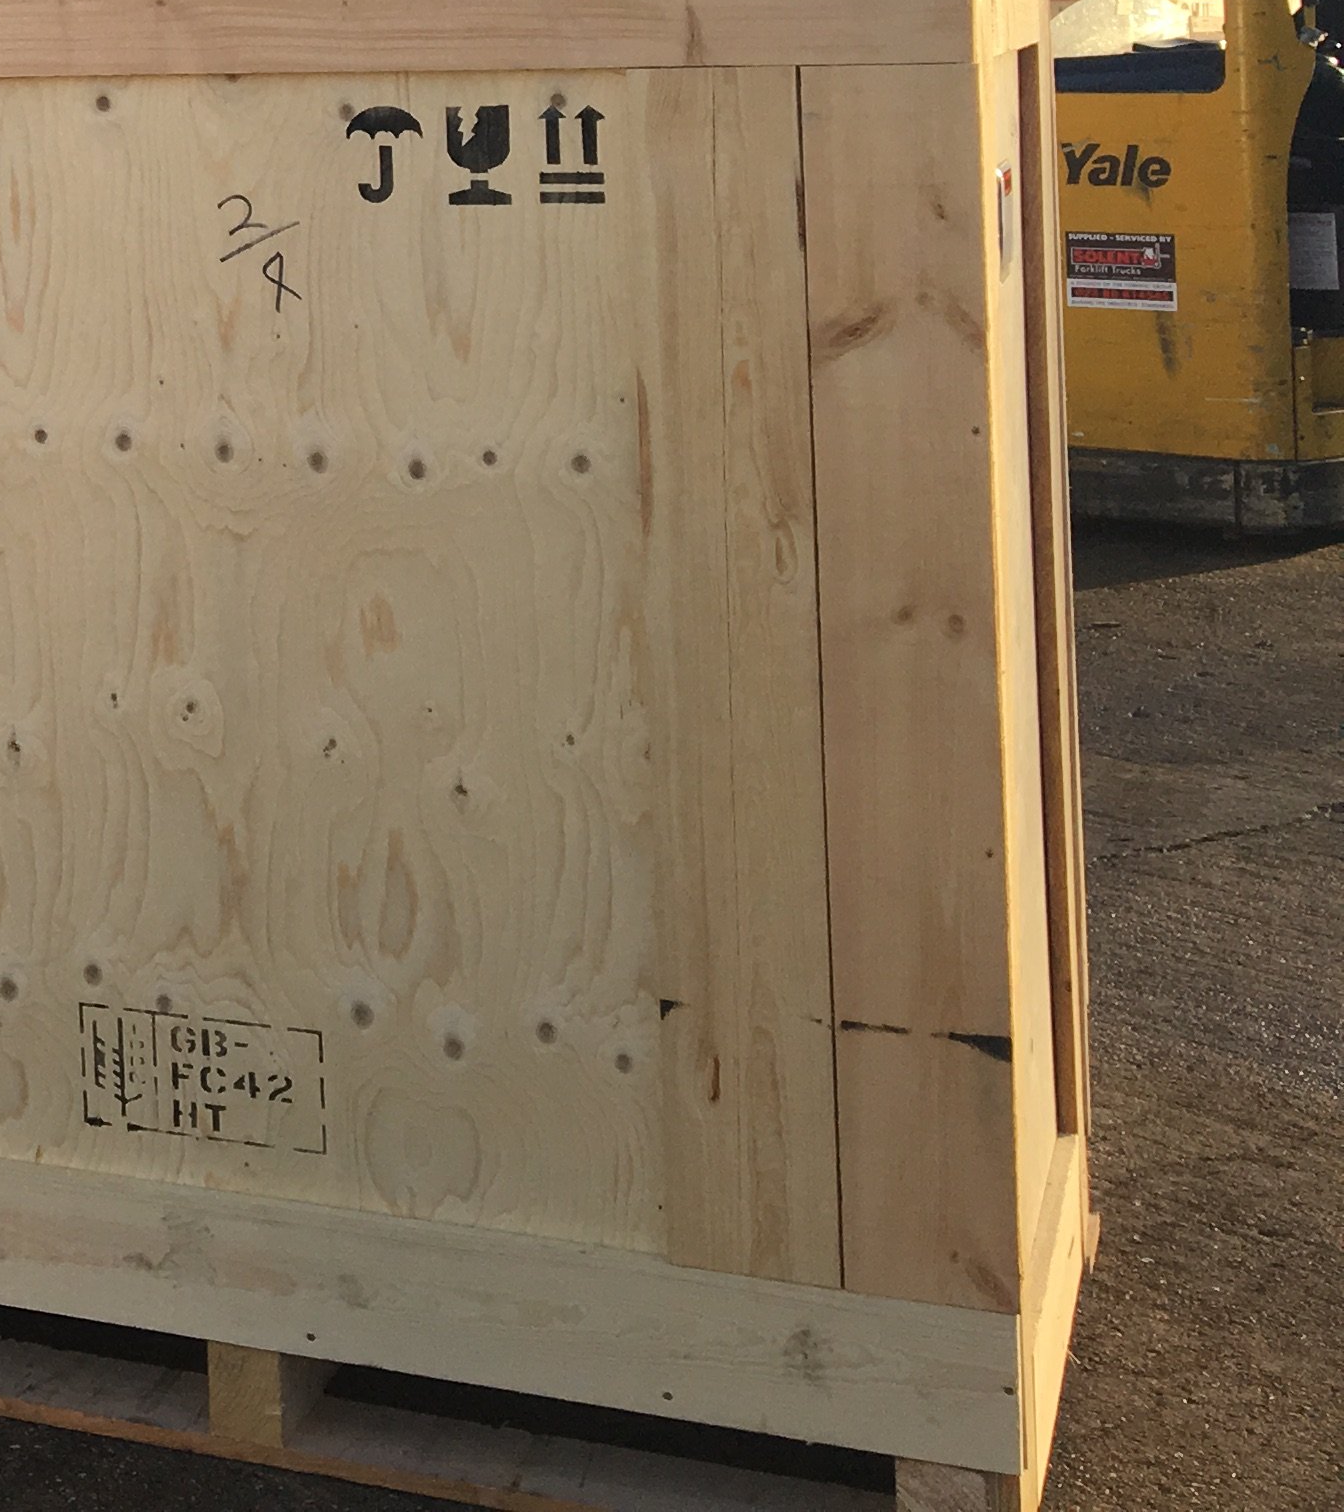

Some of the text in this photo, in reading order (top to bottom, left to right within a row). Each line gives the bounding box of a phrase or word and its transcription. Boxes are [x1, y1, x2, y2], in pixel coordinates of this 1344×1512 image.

[1060, 142, 1172, 188] Yale
[1068, 233, 1108, 241] SUPPLIED
[1115, 234, 1158, 243] SERVICED
[1073, 248, 1140, 265] SOLENT
[1074, 264, 1142, 276] Forklift Trucks
[171, 1061, 294, 1104] FC42
[172, 1099, 228, 1133] HT
